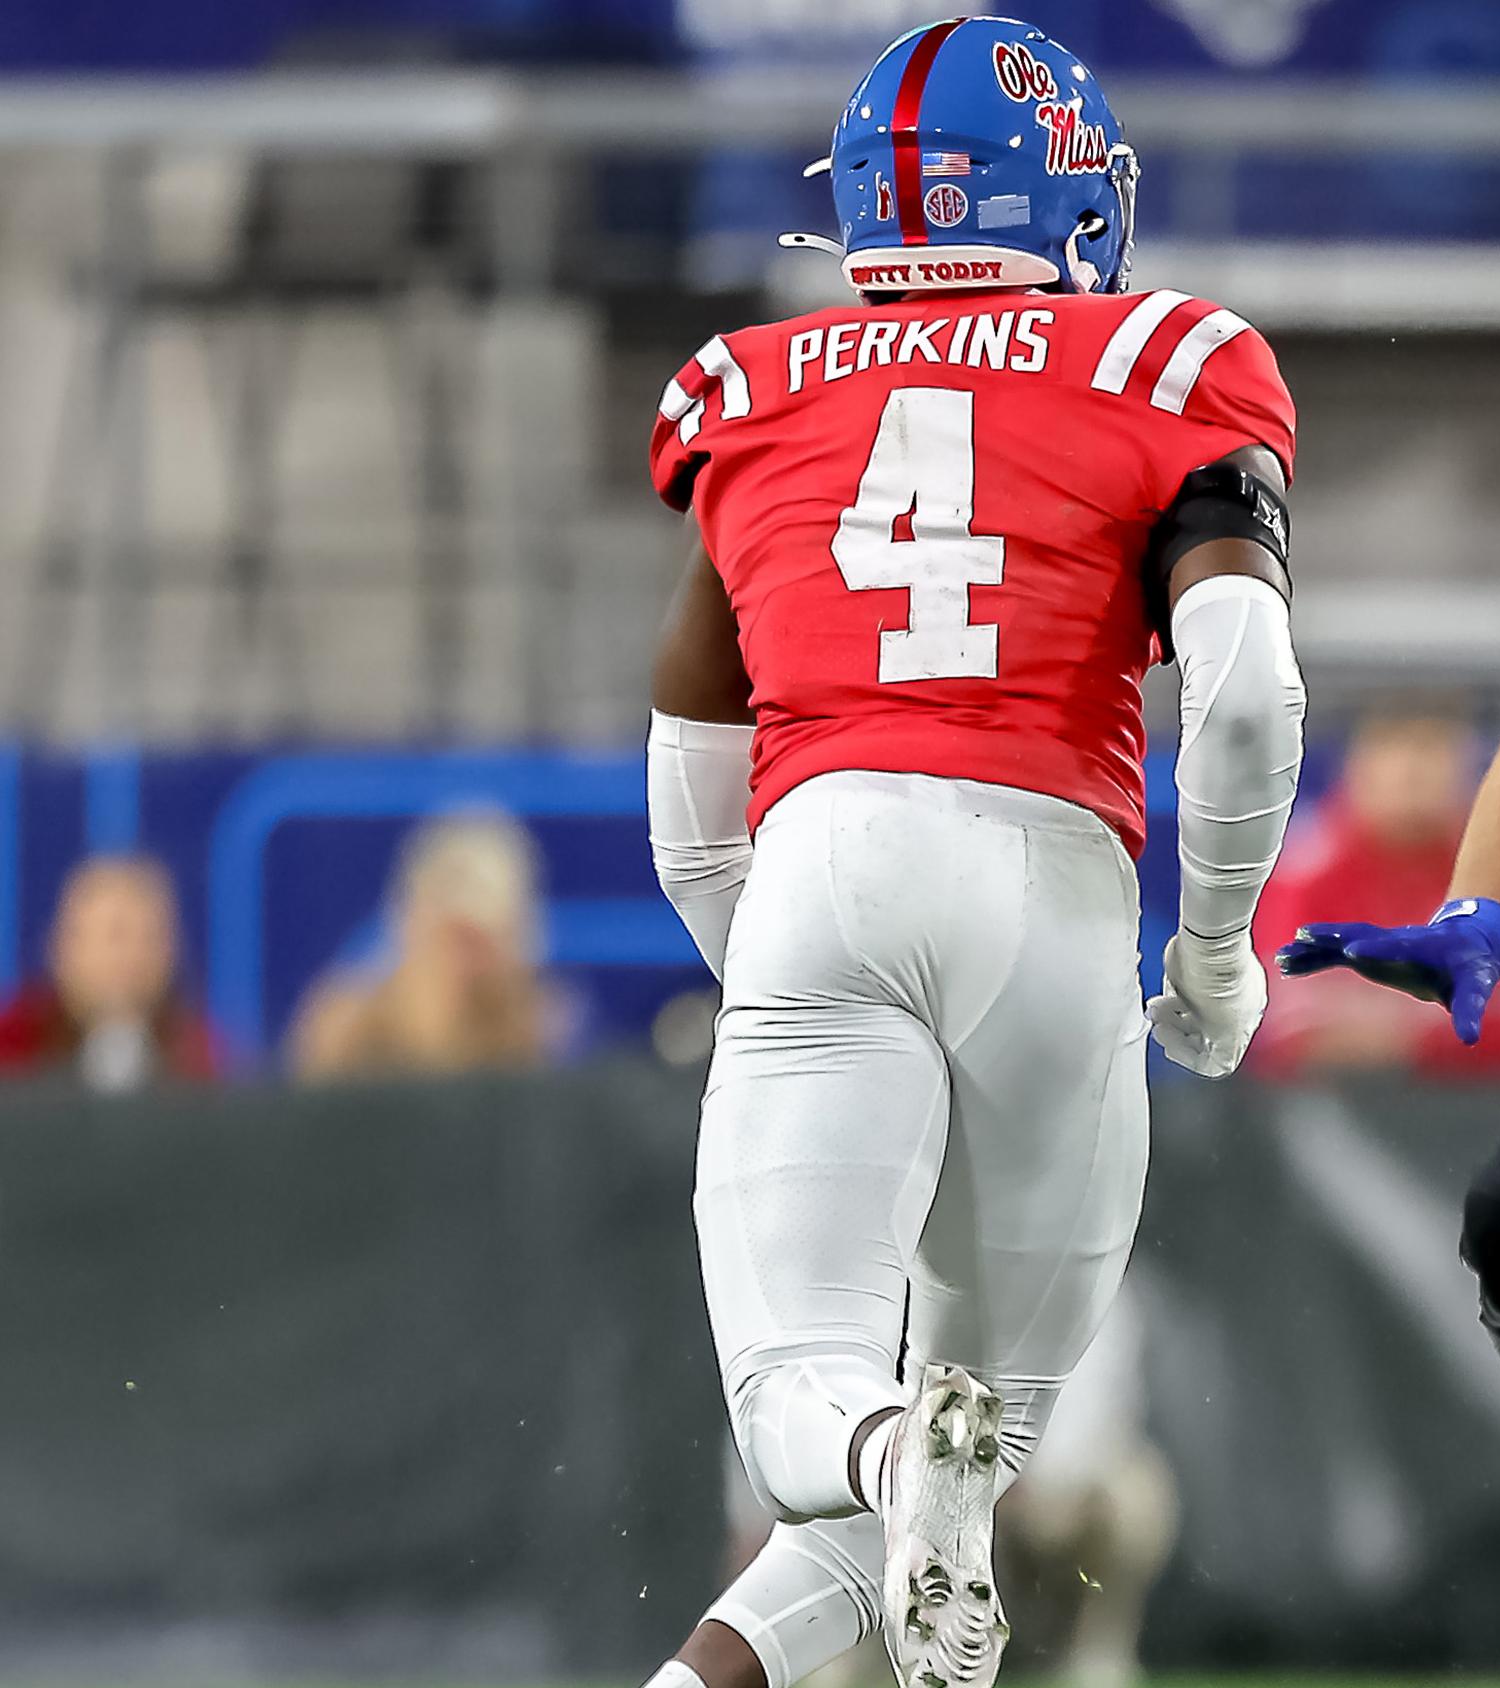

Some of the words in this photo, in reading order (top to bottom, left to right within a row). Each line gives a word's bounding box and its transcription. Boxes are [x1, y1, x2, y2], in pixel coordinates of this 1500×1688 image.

[992, 41, 1058, 102] Ole
[1036, 102, 1108, 175] Miss
[926, 187, 966, 223] SEC
[917, 261, 1002, 281] TODDY
[788, 309, 1055, 394] PERKINS
[830, 387, 1004, 684] 4
